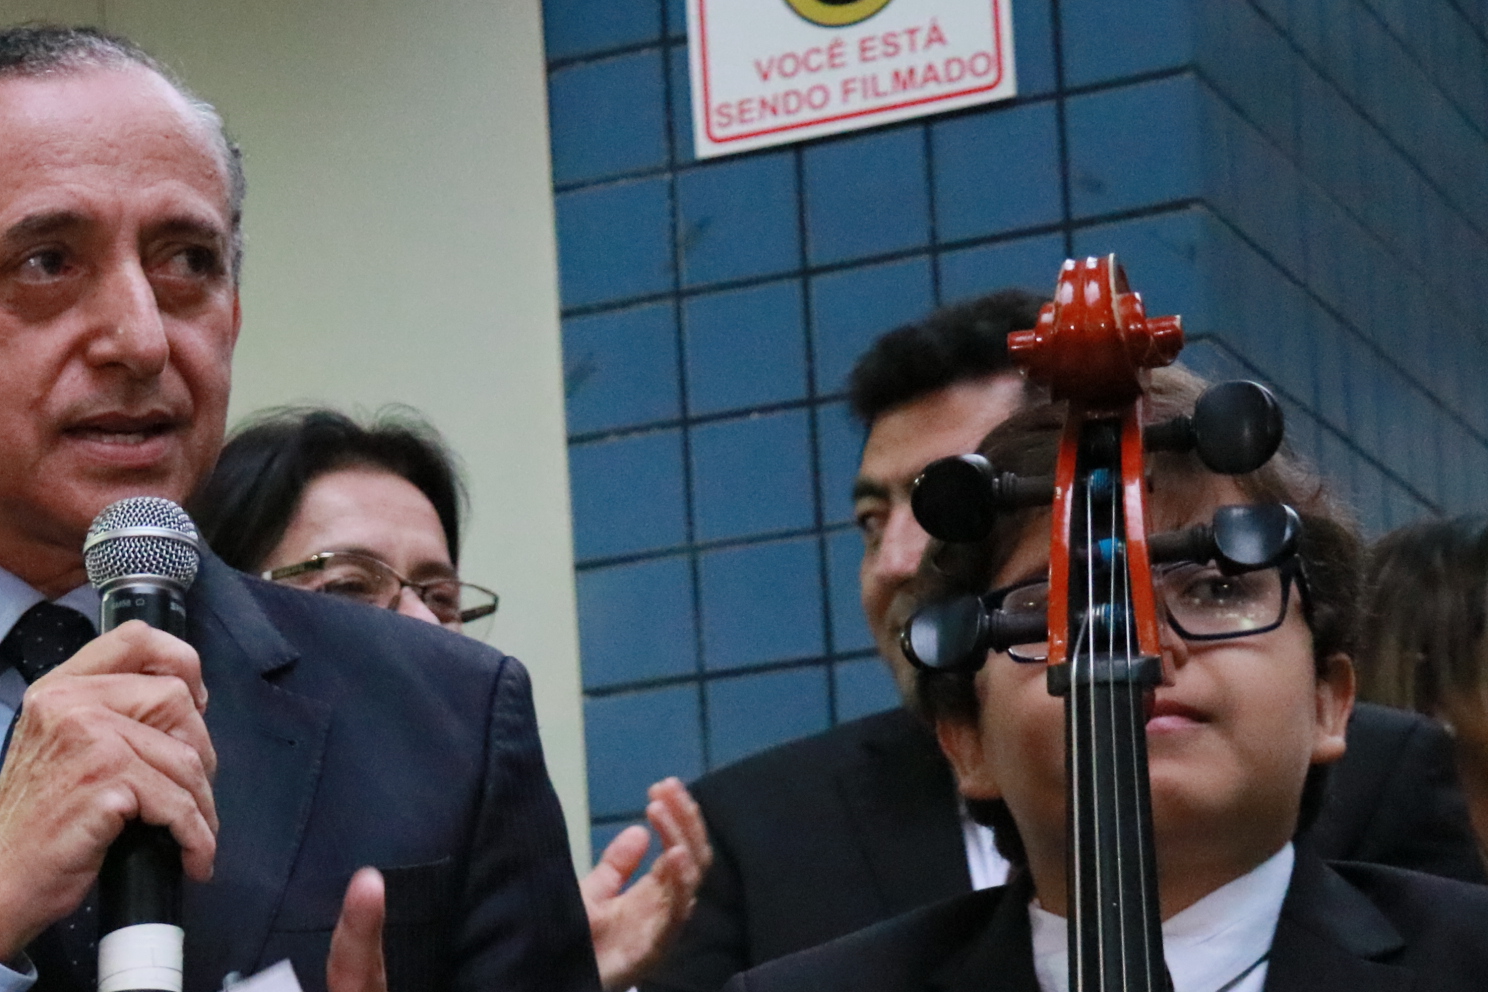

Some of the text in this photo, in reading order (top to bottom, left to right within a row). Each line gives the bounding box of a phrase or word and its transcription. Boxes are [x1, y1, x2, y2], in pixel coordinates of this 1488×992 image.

[753, 16, 948, 82] VOCÊ ESTÁ
[715, 51, 992, 128] SENDO FILMADO
